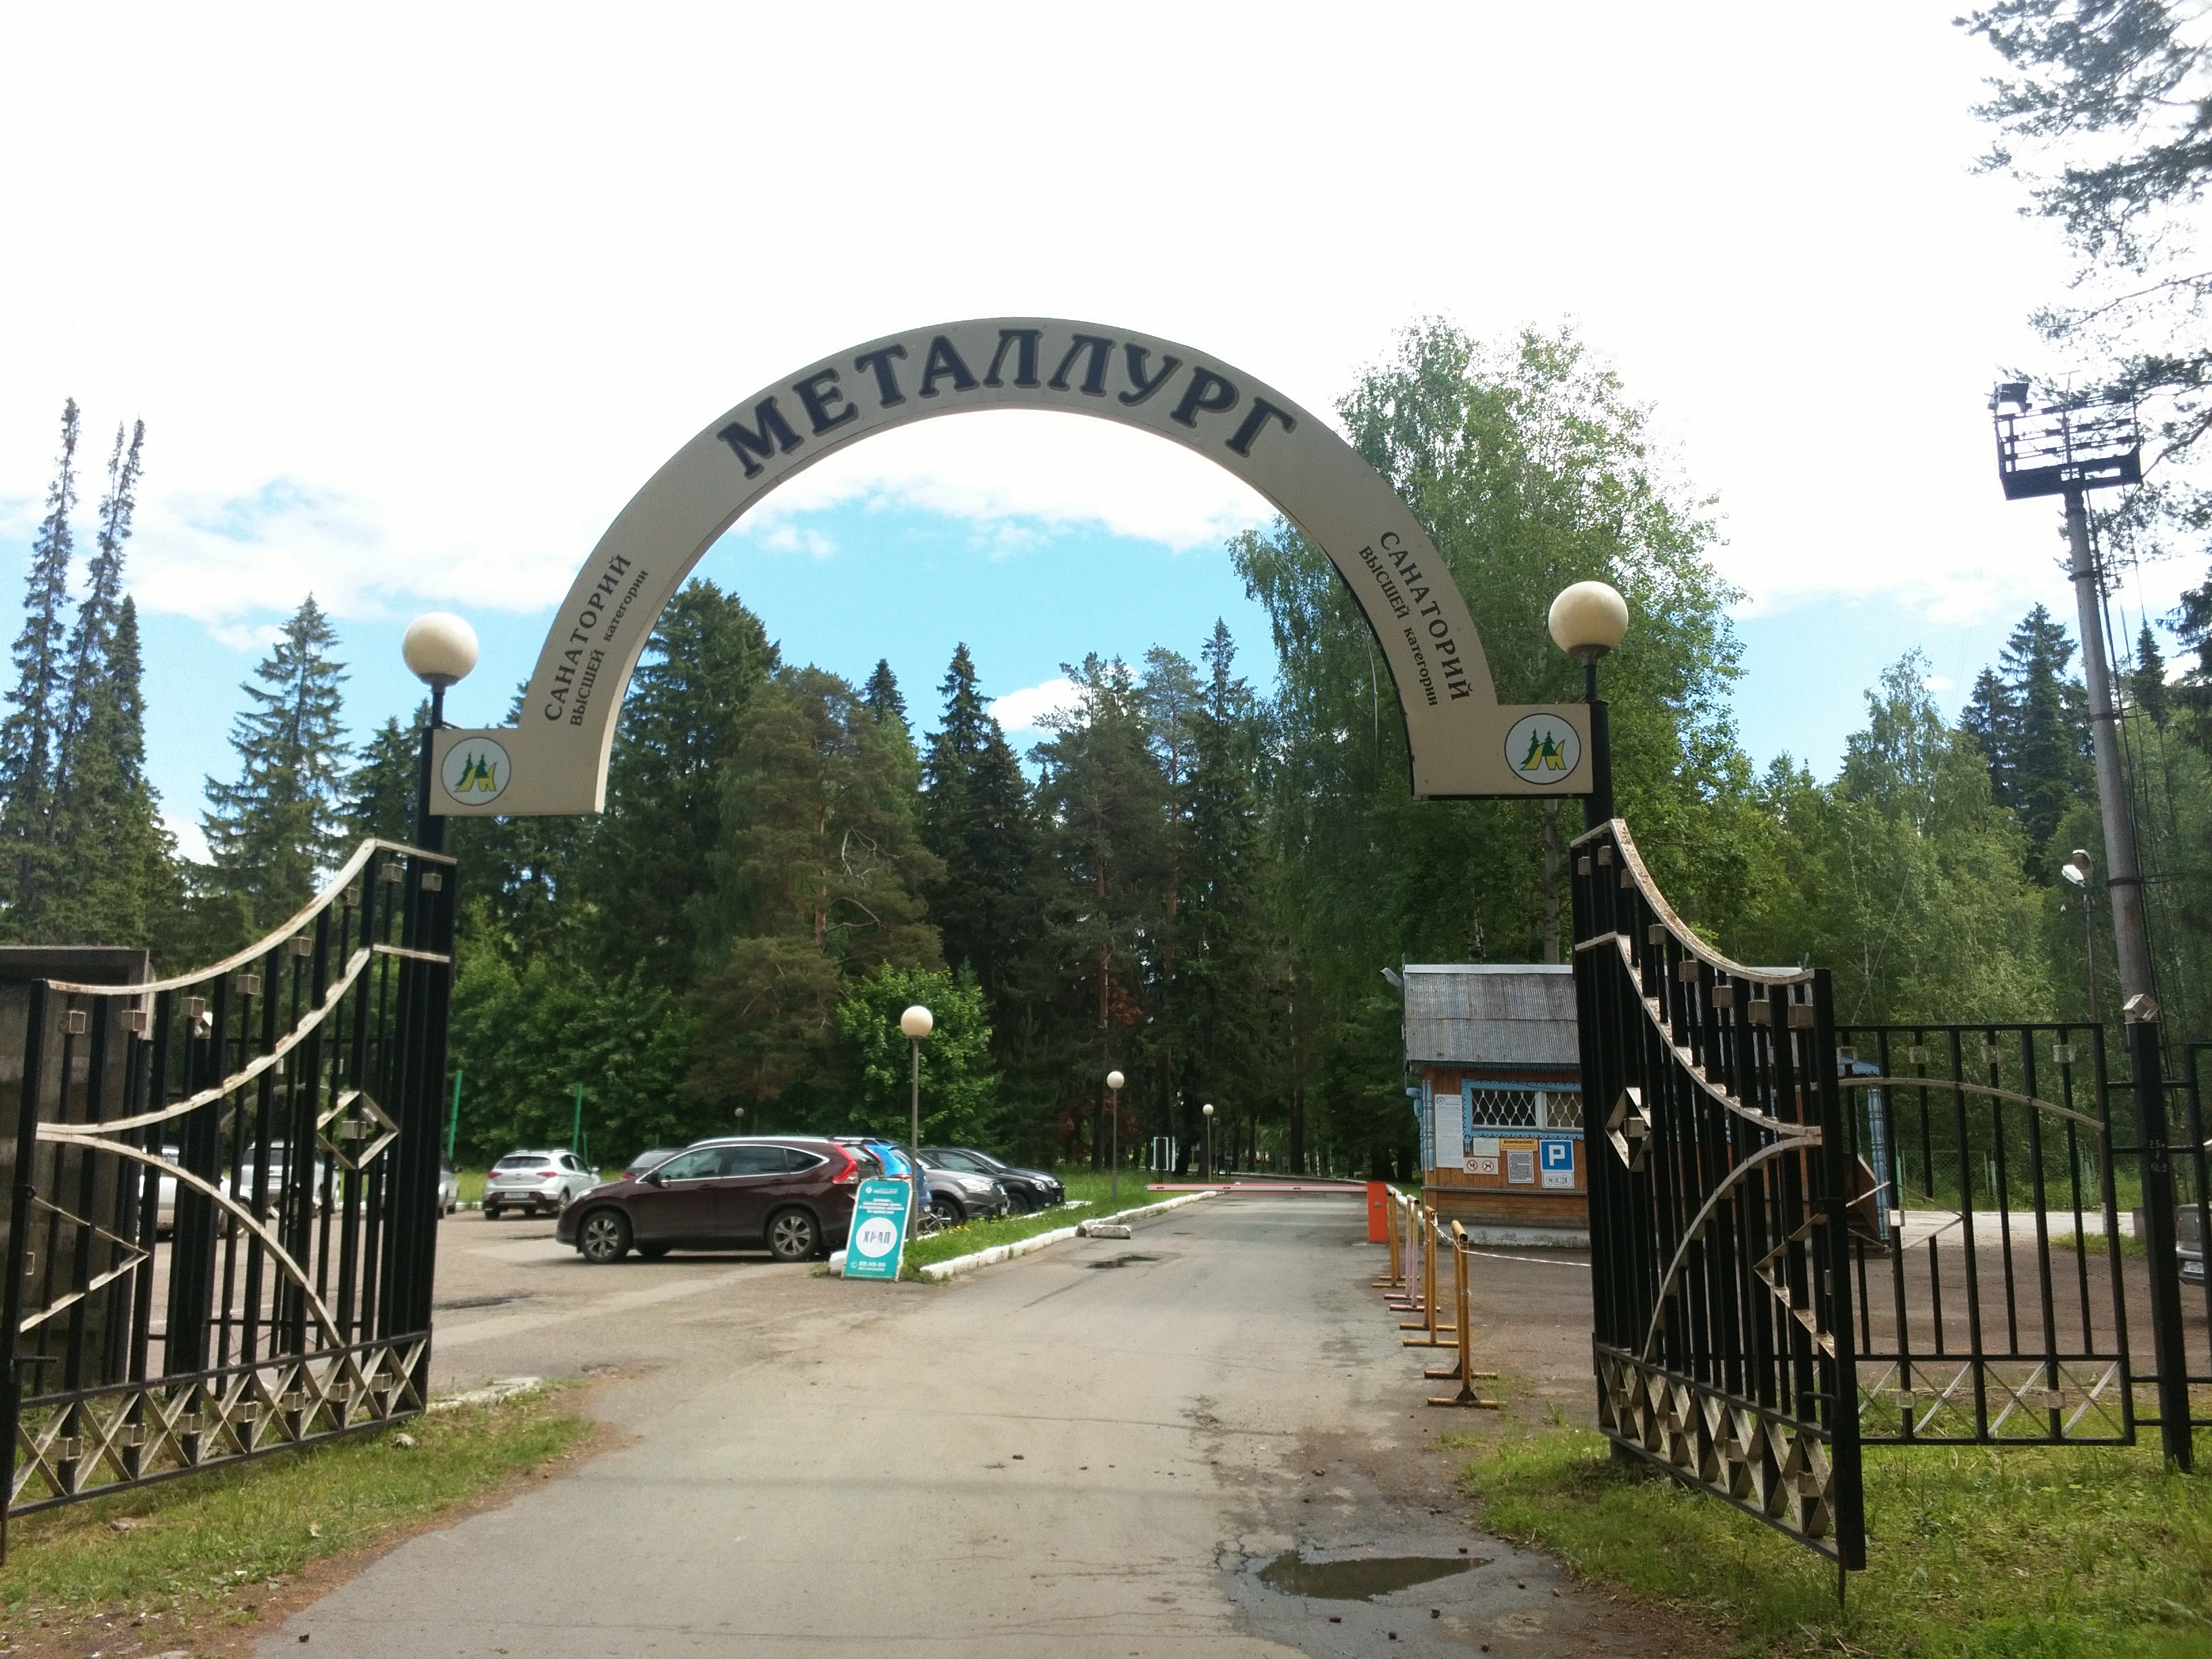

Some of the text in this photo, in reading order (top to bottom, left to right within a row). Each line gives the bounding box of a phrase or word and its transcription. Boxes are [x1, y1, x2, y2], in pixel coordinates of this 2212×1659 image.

[716, 328, 1297, 479] МЕТАЛЛУРГ
[544, 554, 632, 722] САНАТОРИЙ
[570, 569, 649, 727] ВЫСШЕЙ категории
[1359, 546, 1438, 707] ВЫСШЕЙ категории
[1380, 531, 1473, 702] САНАТОРИЙ
[1549, 1145, 1565, 1166] P
